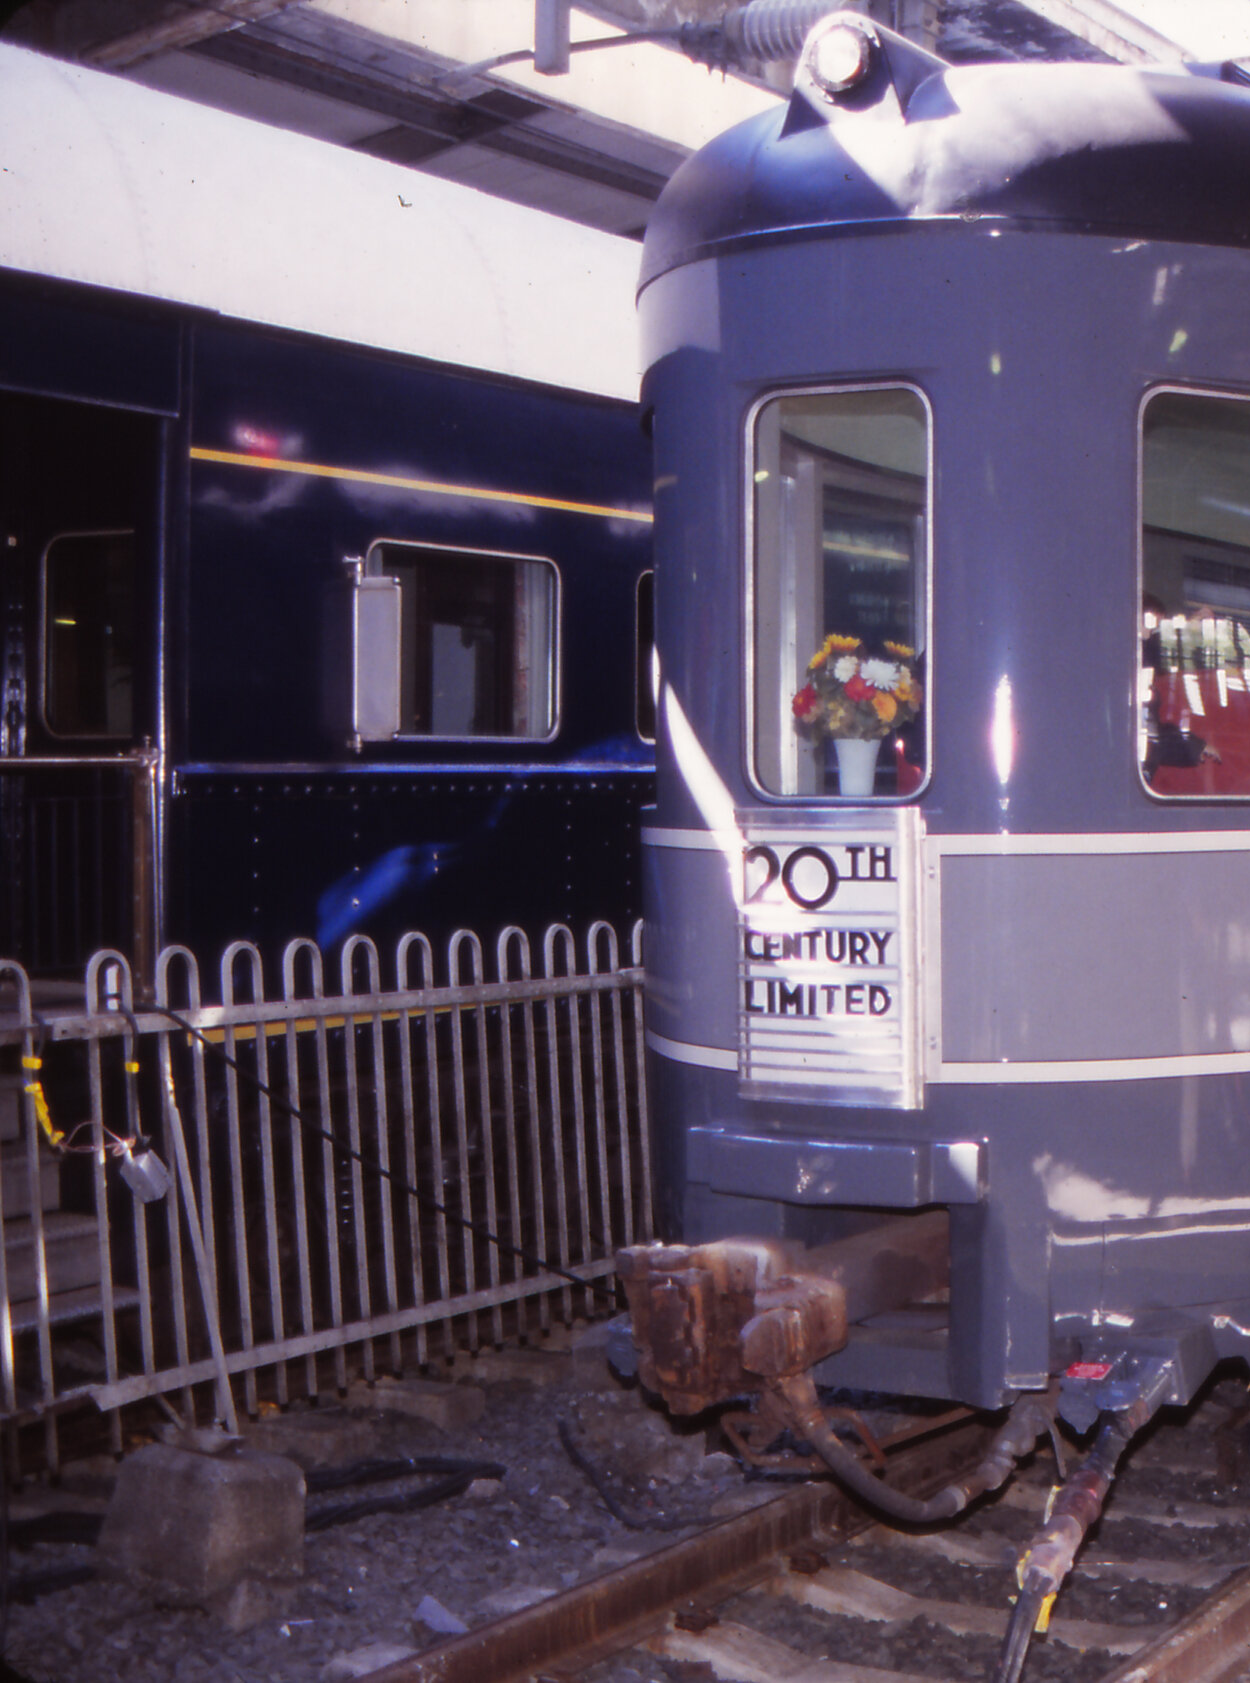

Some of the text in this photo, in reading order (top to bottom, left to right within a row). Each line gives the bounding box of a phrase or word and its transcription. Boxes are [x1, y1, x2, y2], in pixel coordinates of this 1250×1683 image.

[744, 845, 897, 911] 20TH
[744, 930, 894, 965] CENTURY
[745, 980, 892, 1016] LIMITED
